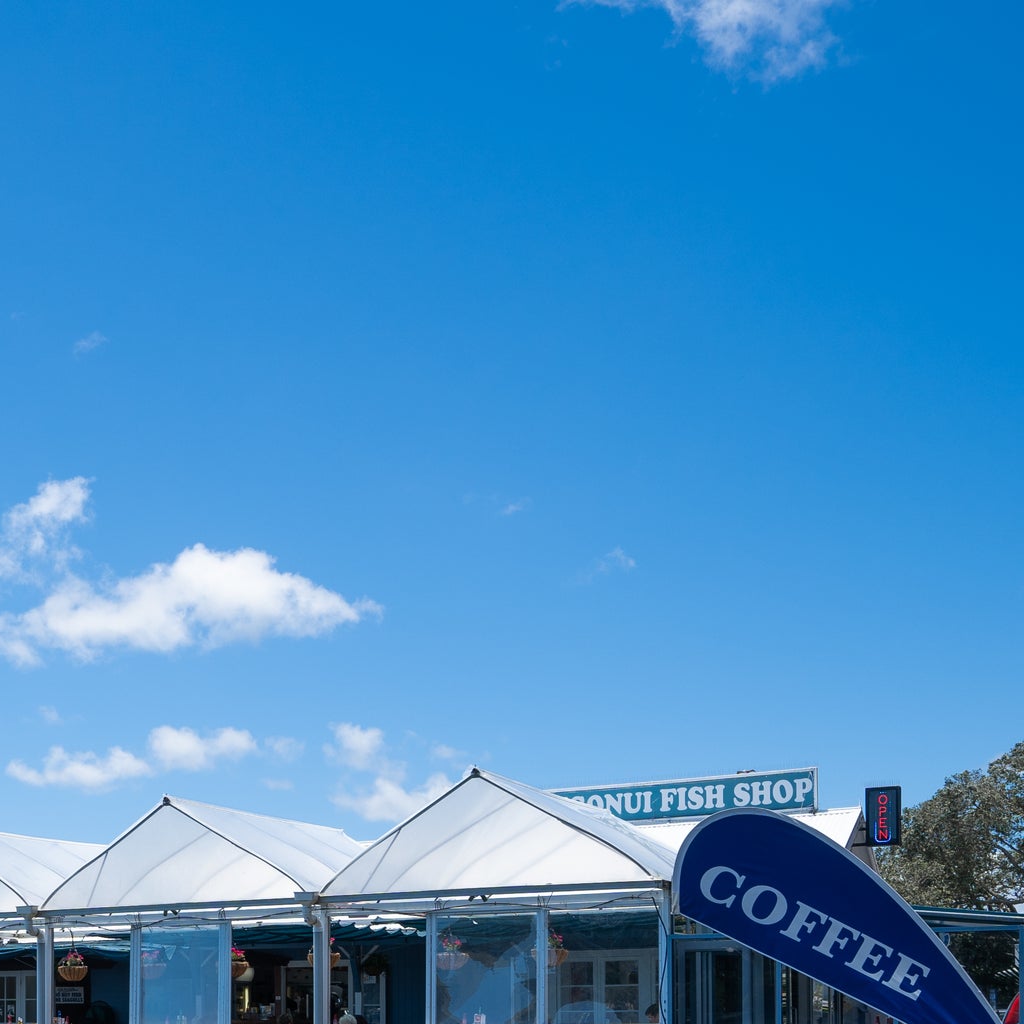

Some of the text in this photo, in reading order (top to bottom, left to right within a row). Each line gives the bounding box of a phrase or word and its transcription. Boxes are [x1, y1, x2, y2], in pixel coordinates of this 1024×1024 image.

[659, 784, 726, 812] FISH
[733, 778, 813, 807] SHOP
[878, 794, 888, 840] OPEN
[699, 865, 931, 1002] COFFEE
